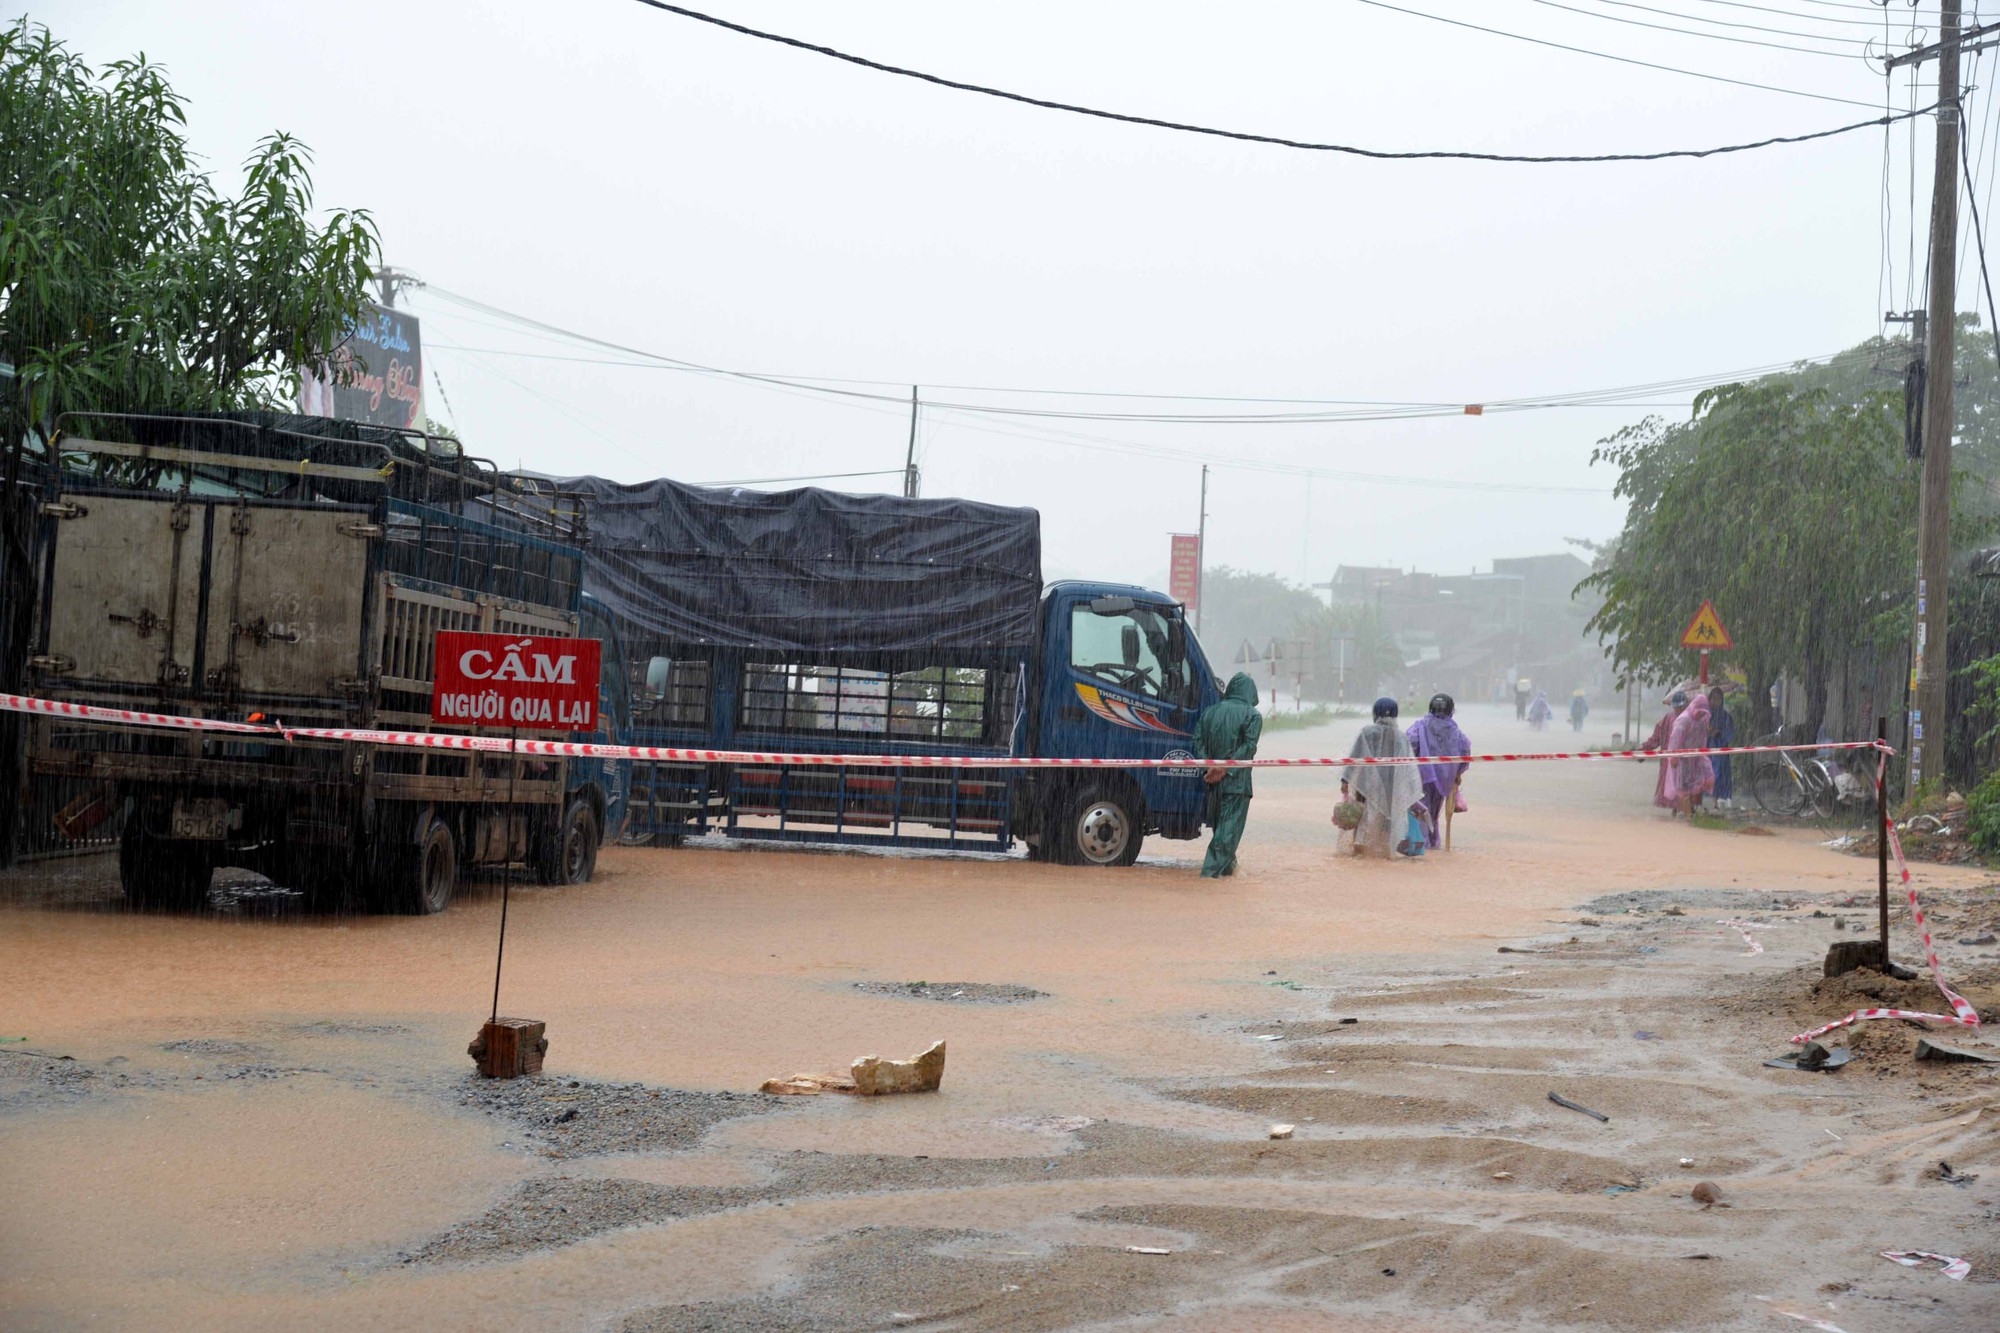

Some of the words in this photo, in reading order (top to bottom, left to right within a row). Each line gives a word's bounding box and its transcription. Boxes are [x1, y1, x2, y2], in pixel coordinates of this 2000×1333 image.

[459, 638, 577, 684] CẤM
[440, 689, 505, 719] NGƯỜI
[510, 697, 552, 722] QUA
[558, 700, 590, 730] LẠI
